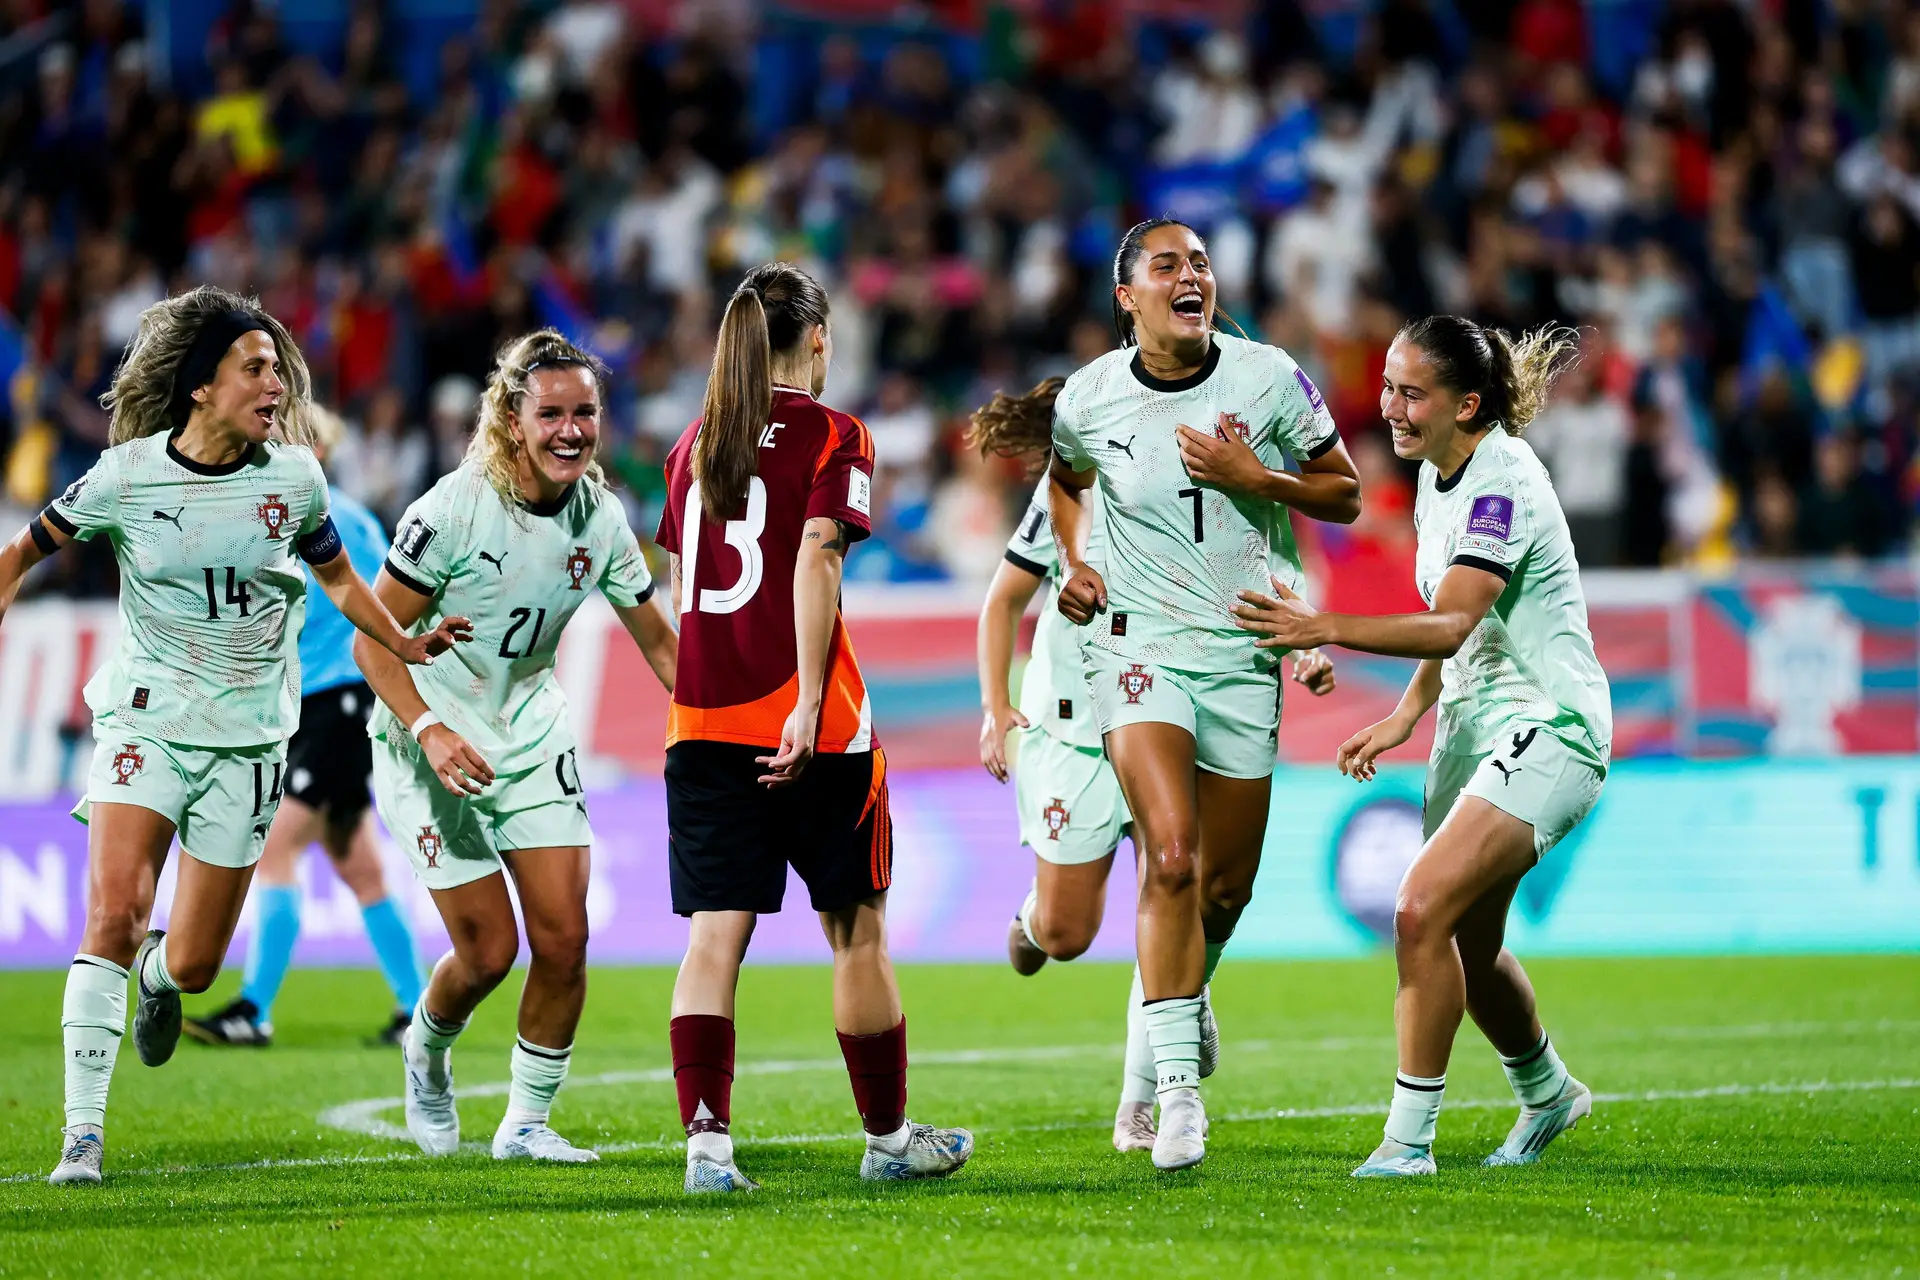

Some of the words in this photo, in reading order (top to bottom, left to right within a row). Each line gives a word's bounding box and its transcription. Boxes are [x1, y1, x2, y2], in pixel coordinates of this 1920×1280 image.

[1178, 487, 1204, 544] 7
[1471, 523, 1507, 535] QUALIFIERS
[1473, 518, 1507, 530] EUROPEAN
[681, 475, 768, 615] 13
[1460, 540, 1506, 555] FOUNDATION
[200, 566, 252, 620] 14
[498, 607, 547, 659] 21
